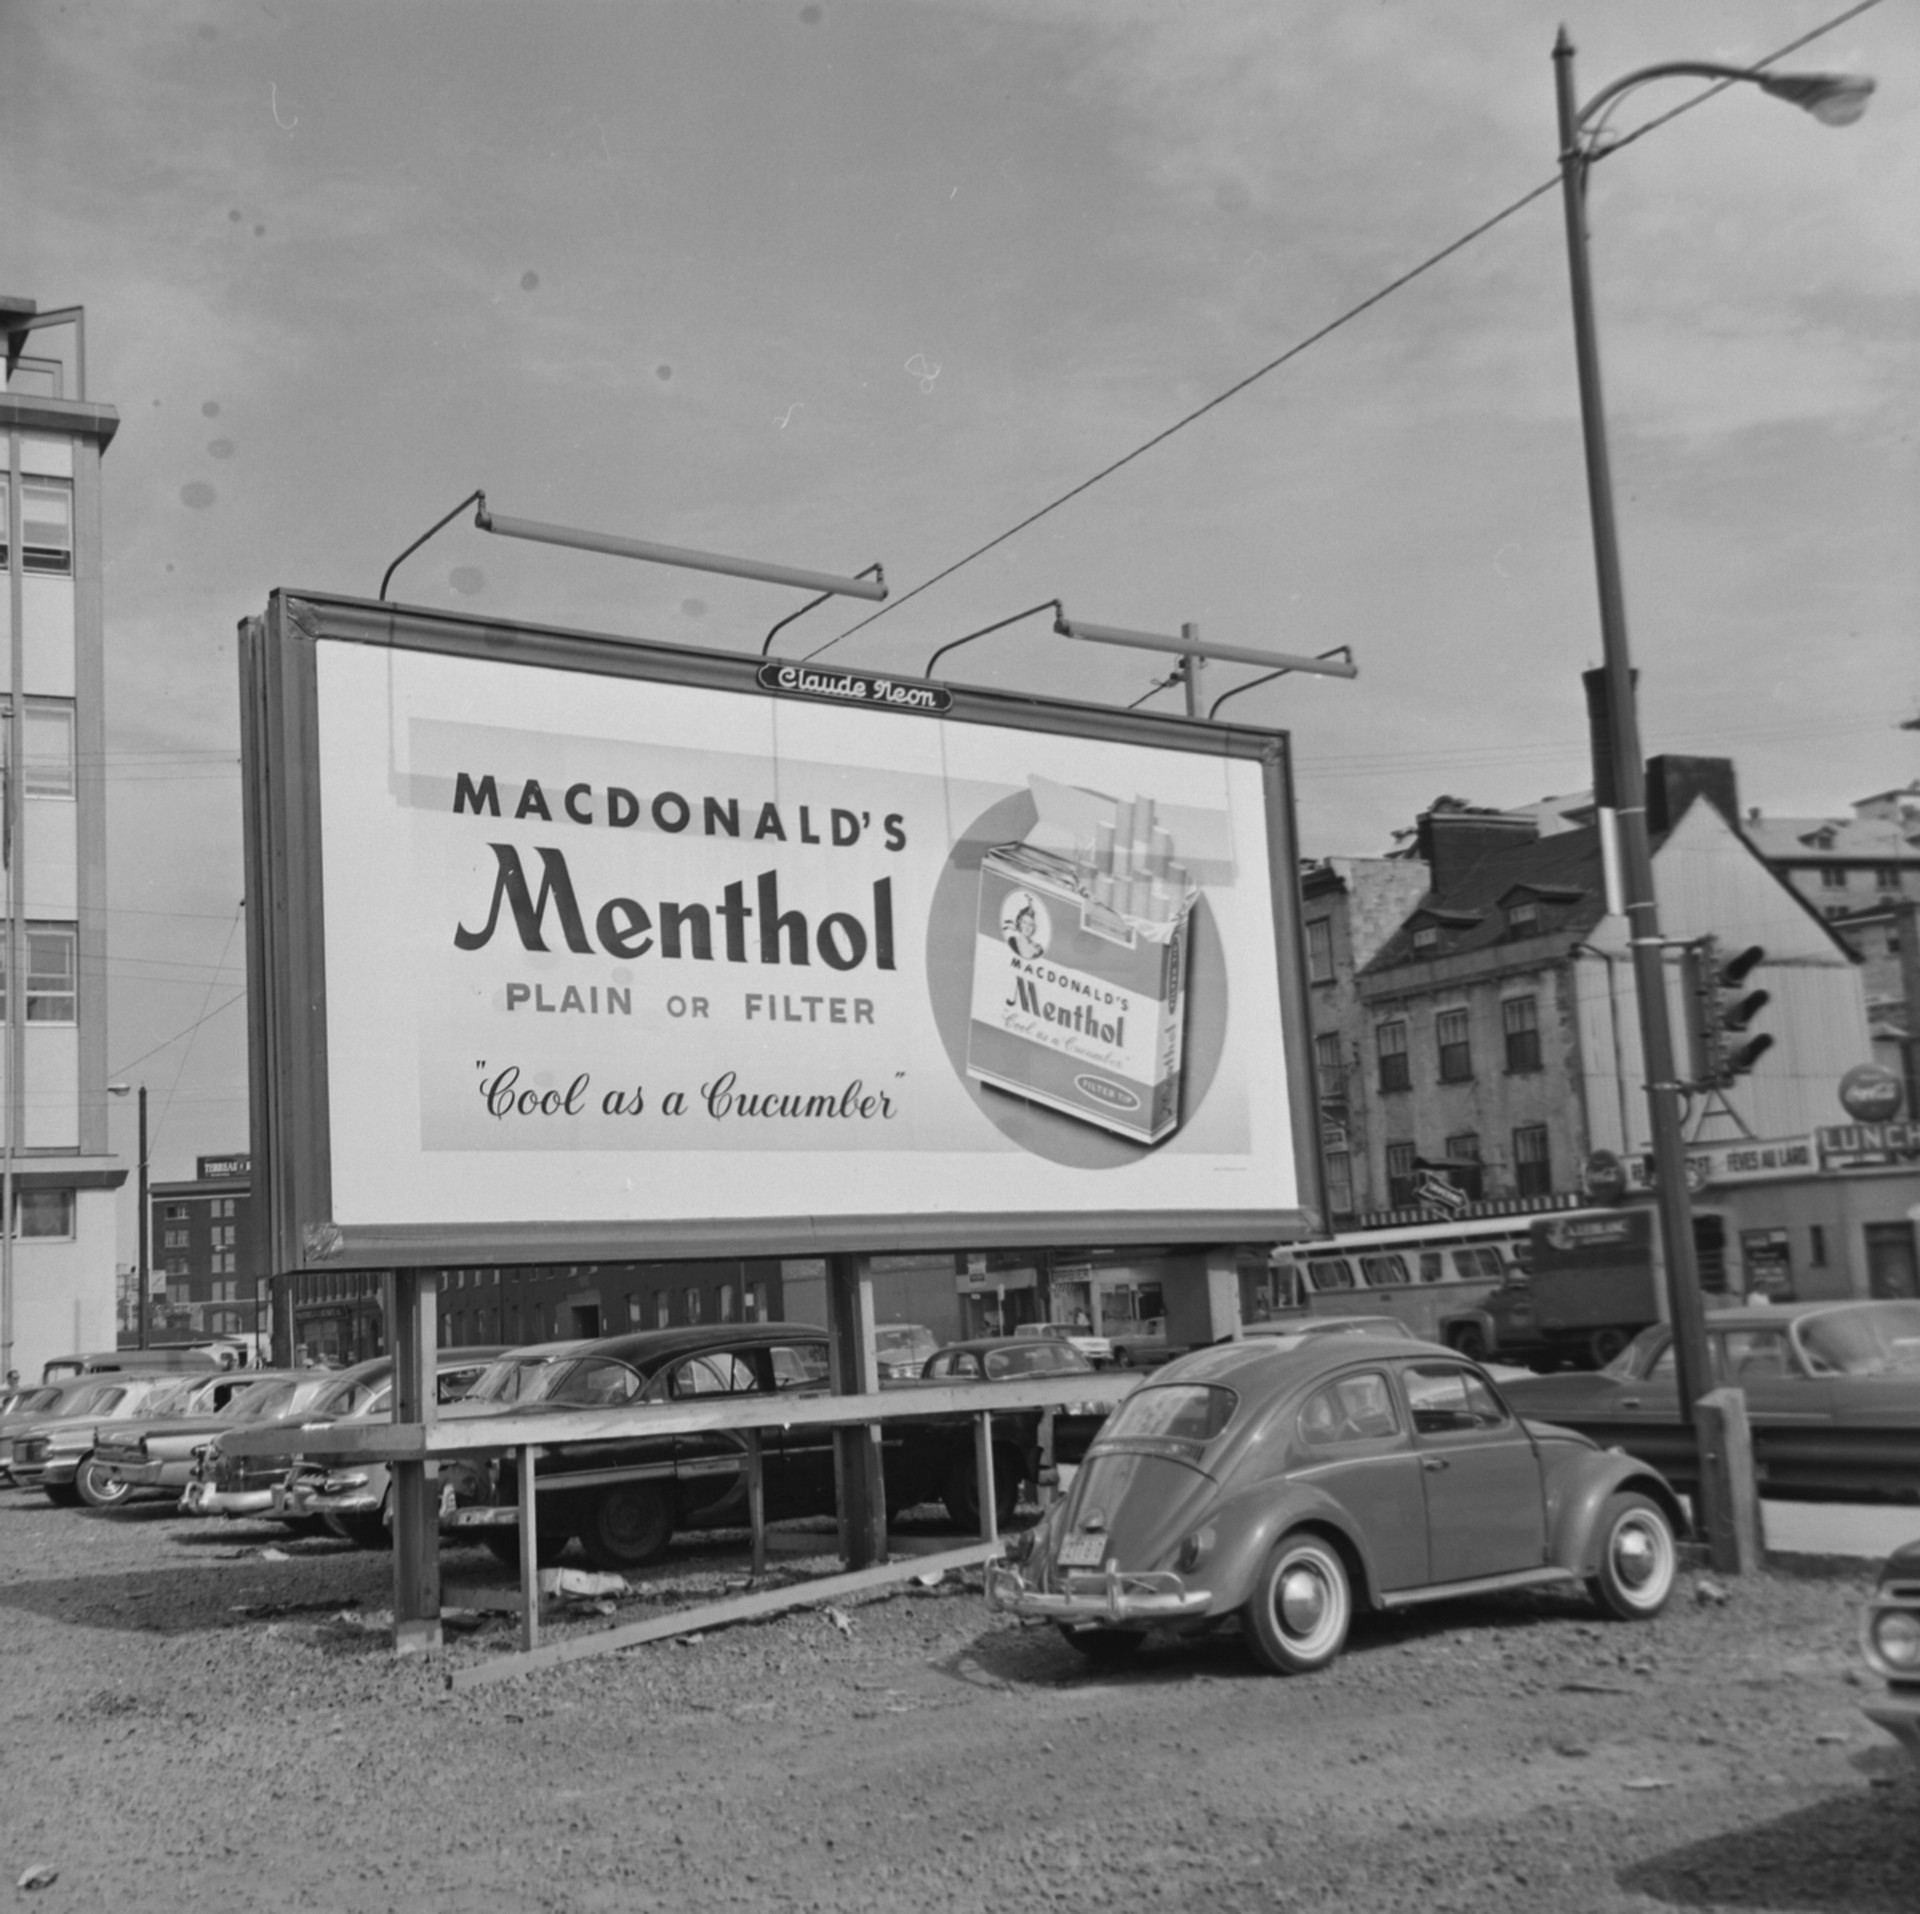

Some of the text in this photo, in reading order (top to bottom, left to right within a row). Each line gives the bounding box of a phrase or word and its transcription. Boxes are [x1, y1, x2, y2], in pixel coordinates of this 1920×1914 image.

[777, 666, 936, 708] Claude Neon
[452, 771, 907, 852] MACDONALD'S
[453, 842, 898, 972] Menthol
[505, 982, 875, 1025] PLAIN OR FILTER
[1010, 957, 1129, 1012] MACDONALD'S
[1005, 975, 1124, 1048] Menthol
[602, 1085, 645, 1116] as
[662, 1091, 689, 1116] a
[1083, 1079, 1115, 1098] FILTER
